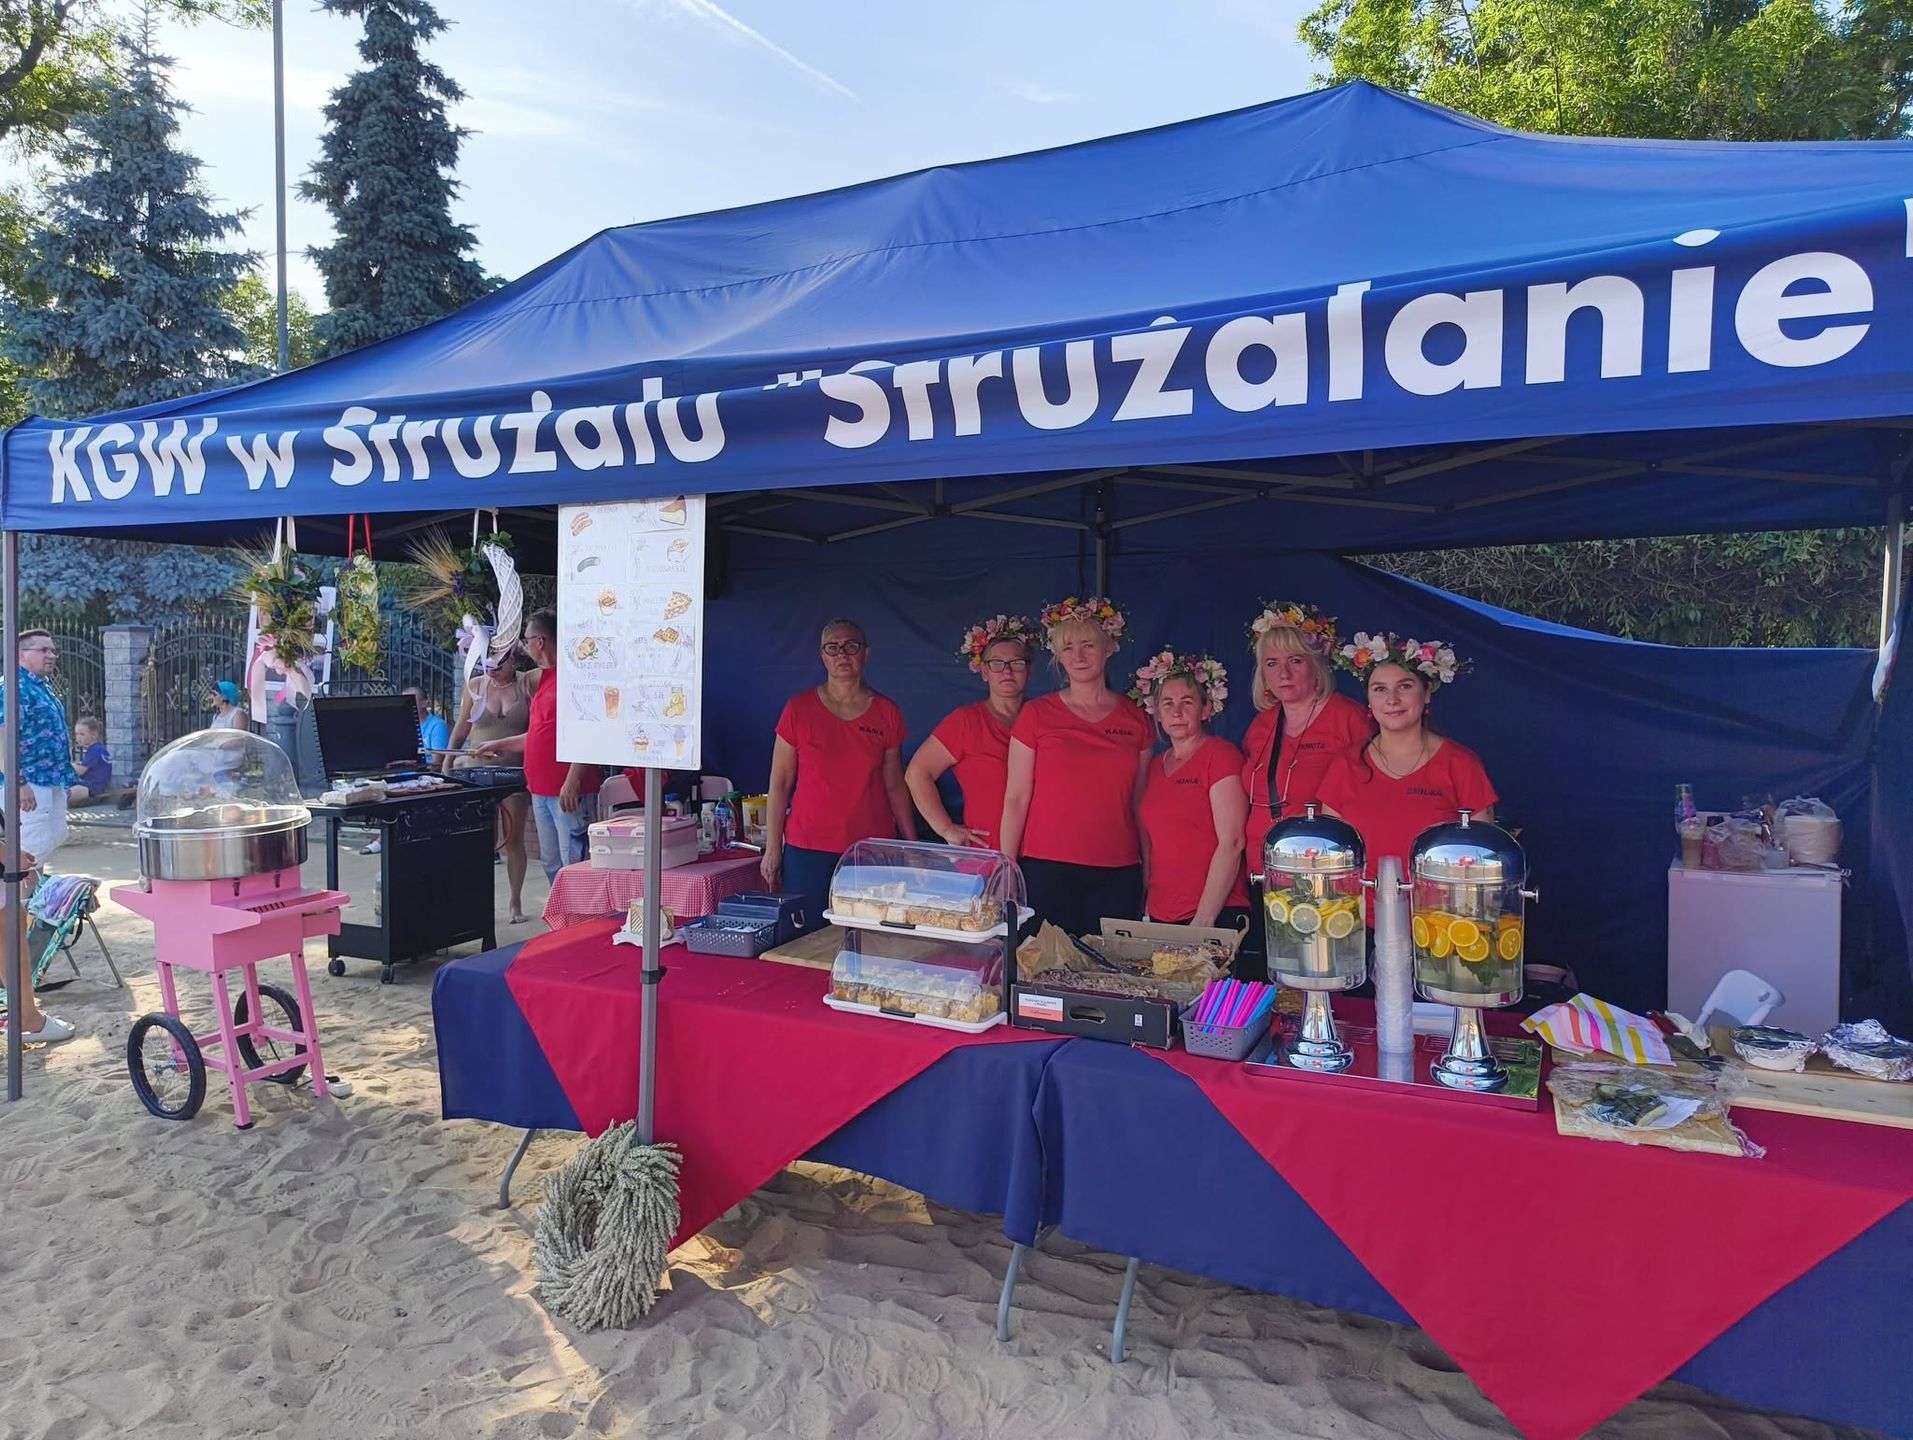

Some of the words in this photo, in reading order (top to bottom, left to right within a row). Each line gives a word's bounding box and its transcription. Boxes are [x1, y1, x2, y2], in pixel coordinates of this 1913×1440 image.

[49, 417, 218, 504] KGW
[226, 430, 300, 490] w
[323, 377, 726, 486] Strużalu
[763, 198, 1913, 448] "Strużalanie
